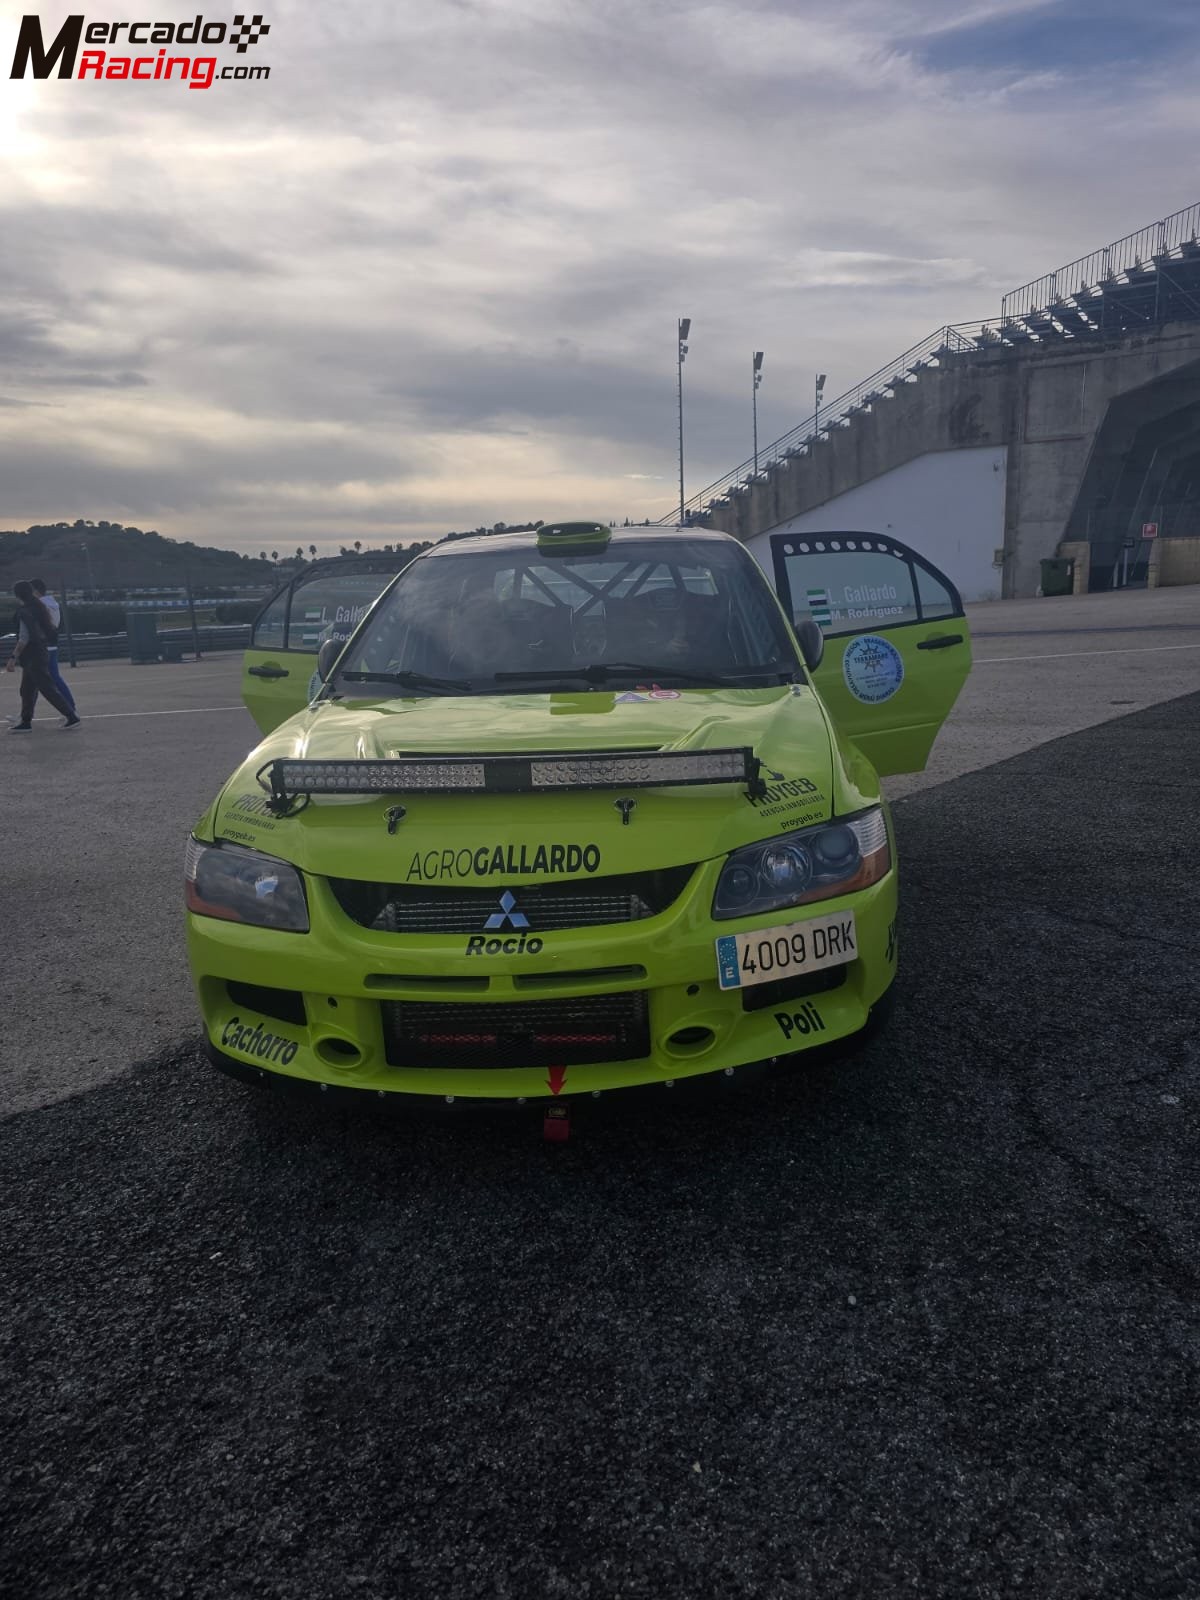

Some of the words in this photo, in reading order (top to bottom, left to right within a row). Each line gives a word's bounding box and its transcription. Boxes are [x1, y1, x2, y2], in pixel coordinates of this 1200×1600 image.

[844, 583, 897, 603] Gallardo
[830, 609, 845, 621] M.
[780, 811, 824, 830] proygeb.es
[465, 928, 543, 956] Rocio
[742, 933, 806, 975] 4009
[812, 920, 856, 960] DRK
[725, 966, 736, 980] E
[773, 1001, 827, 1040] Poli
[221, 1016, 299, 1066] Cachorro
